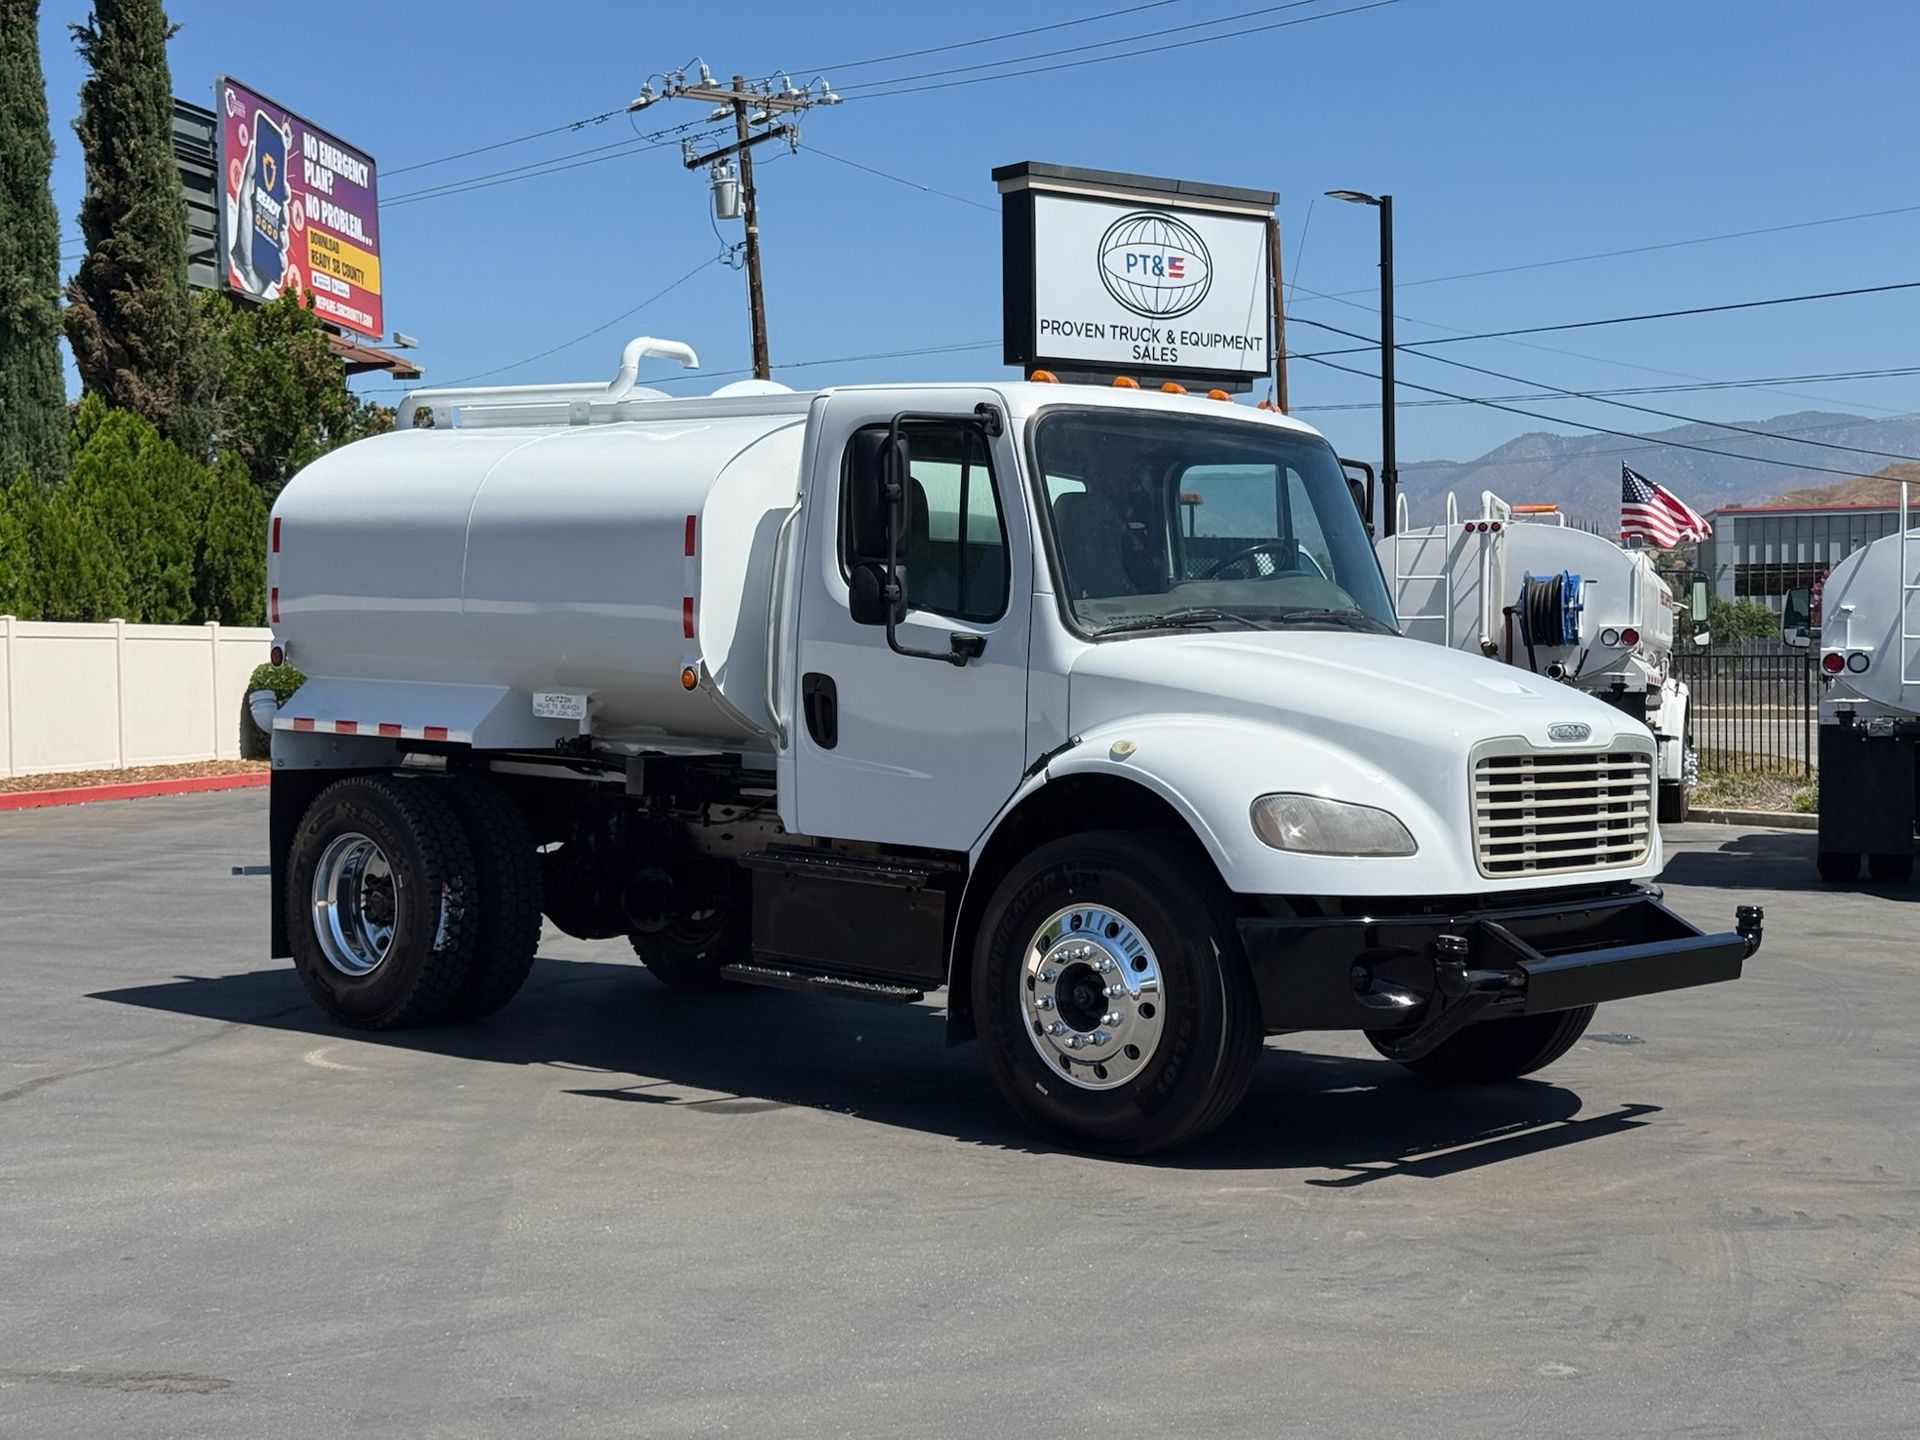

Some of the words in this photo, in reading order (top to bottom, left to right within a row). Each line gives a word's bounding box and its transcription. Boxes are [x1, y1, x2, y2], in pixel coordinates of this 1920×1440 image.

[303, 132, 318, 161] NO
[319, 140, 369, 189] EMERGENCY
[304, 160, 334, 196] PLAN?
[256, 186, 281, 219] READY
[305, 192, 320, 221] NO
[321, 200, 373, 246] PROBLEM...
[310, 230, 340, 254] DOWNLOAD
[311, 249, 331, 271] READY
[332, 258, 341, 274] SB
[341, 262, 365, 286] COUNTY
[1126, 253, 1185, 279] PT&E
[1040, 319, 1105, 340] PROVEN
[1109, 324, 1161, 344] TRUCK
[1166, 331, 1176, 345] &
[1180, 331, 1263, 352] EQUIPMENT
[1132, 345, 1178, 363] SALES
[544, 695, 573, 704] CAUTION
